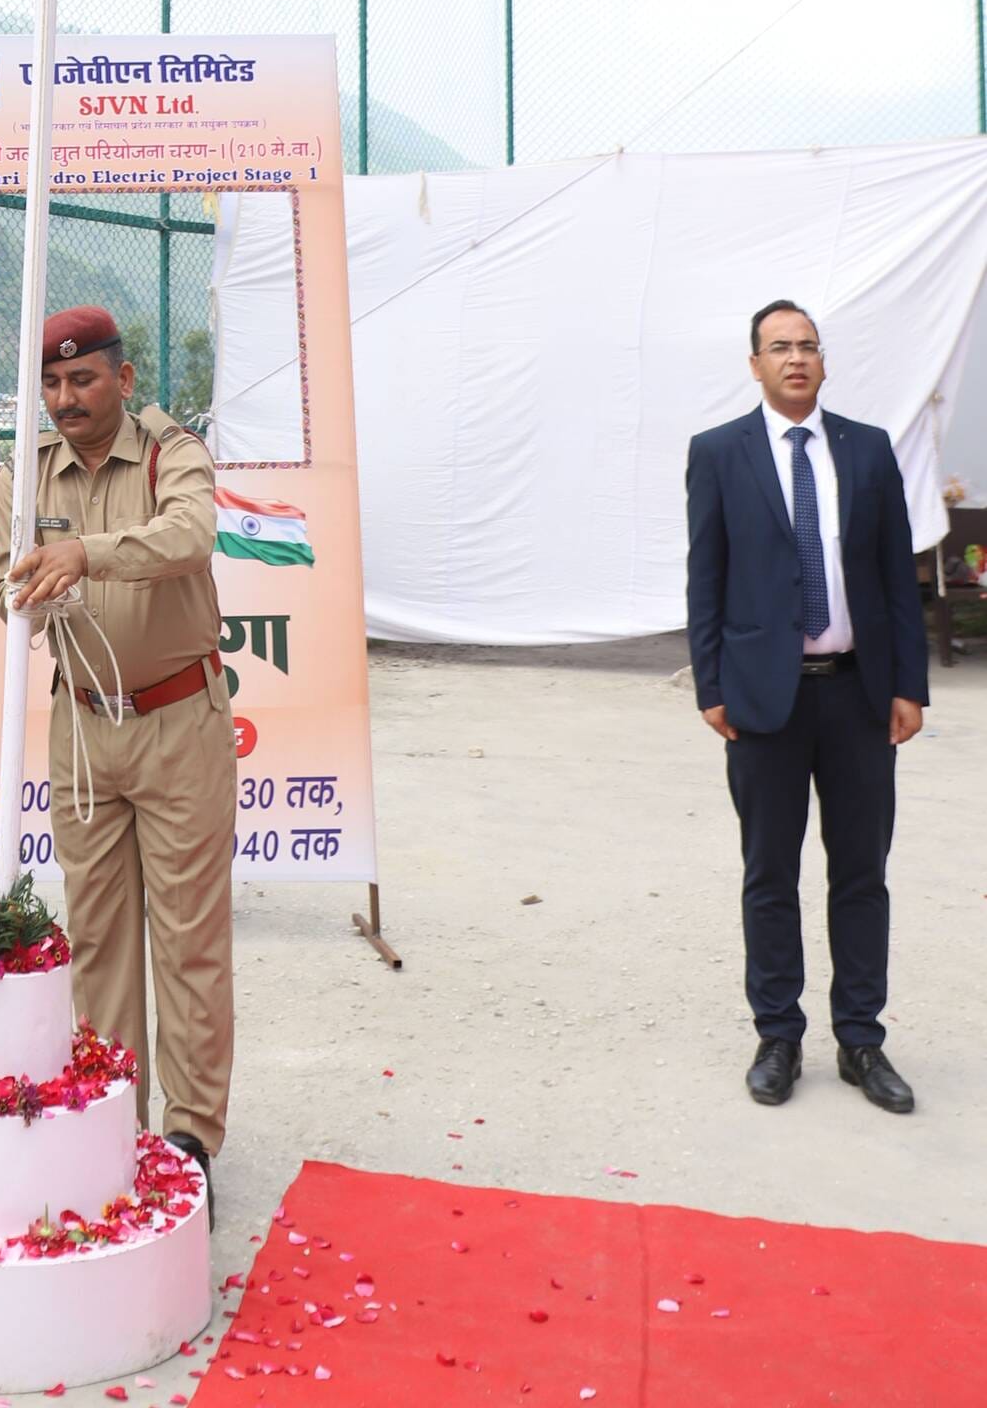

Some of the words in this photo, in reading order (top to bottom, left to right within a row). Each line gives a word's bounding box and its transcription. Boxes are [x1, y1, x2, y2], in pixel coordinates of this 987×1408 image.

[19, 56, 152, 85] एजेवीएन
[157, 54, 256, 83] लिमिटेड
[79, 95, 148, 116] SJVN
[156, 94, 200, 115] Ltd.
[50, 146, 81, 167] द्युत
[84, 139, 165, 163] परियोजना
[92, 170, 166, 184] Electric
[172, 168, 238, 185] Project
[244, 166, 292, 184] Stage
[239, 778, 275, 810] 30
[286, 776, 343, 816] तक,
[233, 830, 279, 862] 40
[290, 828, 342, 861] तक
